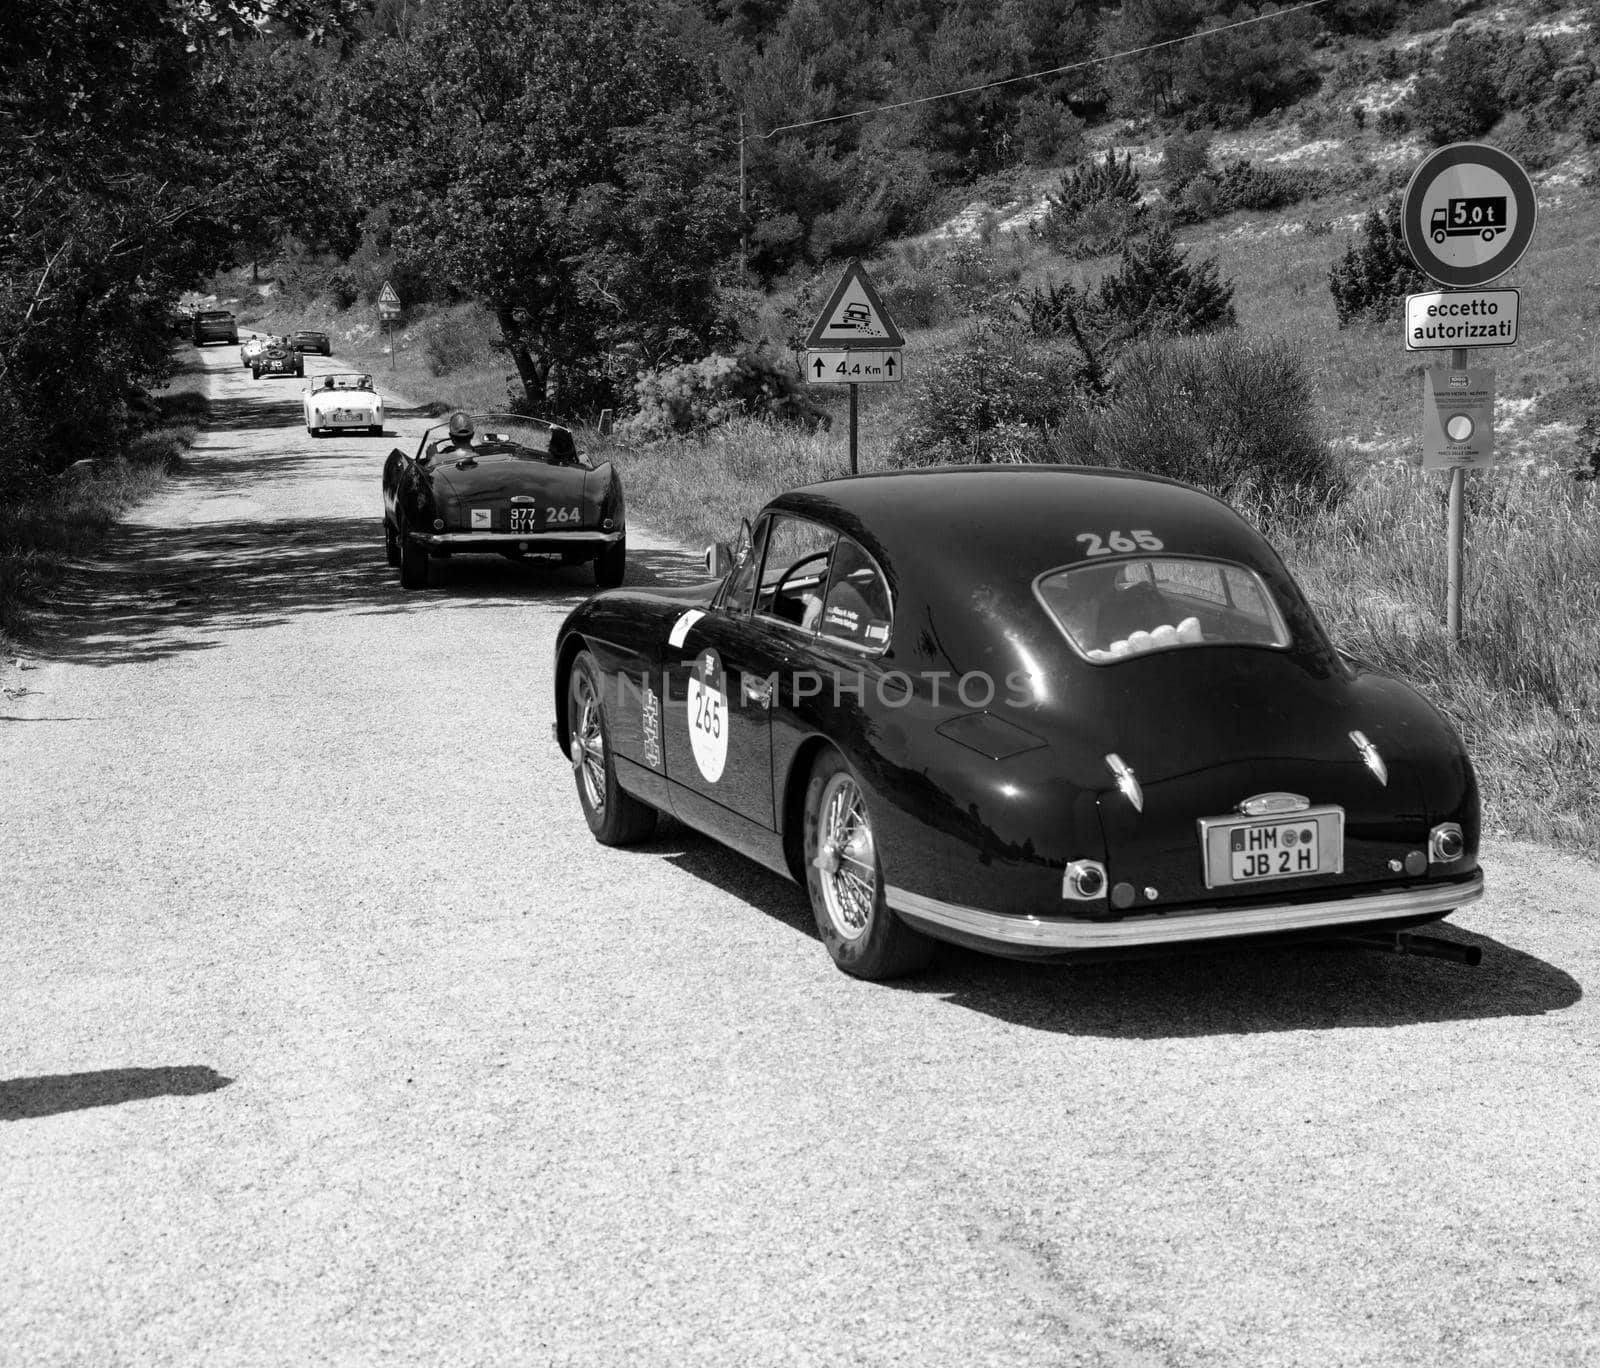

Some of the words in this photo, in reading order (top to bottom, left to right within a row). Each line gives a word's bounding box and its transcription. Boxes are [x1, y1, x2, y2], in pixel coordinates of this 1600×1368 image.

[1427, 299, 1498, 317] eccetto
[1414, 320, 1511, 339] autorizzati
[835, 361, 861, 376] 4.4
[865, 366, 881, 375] Km
[510, 508, 536, 519] 977
[546, 507, 581, 523] 264
[510, 520, 536, 530] UYY
[1076, 529, 1164, 556] 265
[695, 692, 720, 739] 265
[1249, 827, 1277, 851] HM
[1243, 853, 1270, 877] JB
[1279, 850, 1291, 873] 2
[1298, 848, 1311, 870] H
